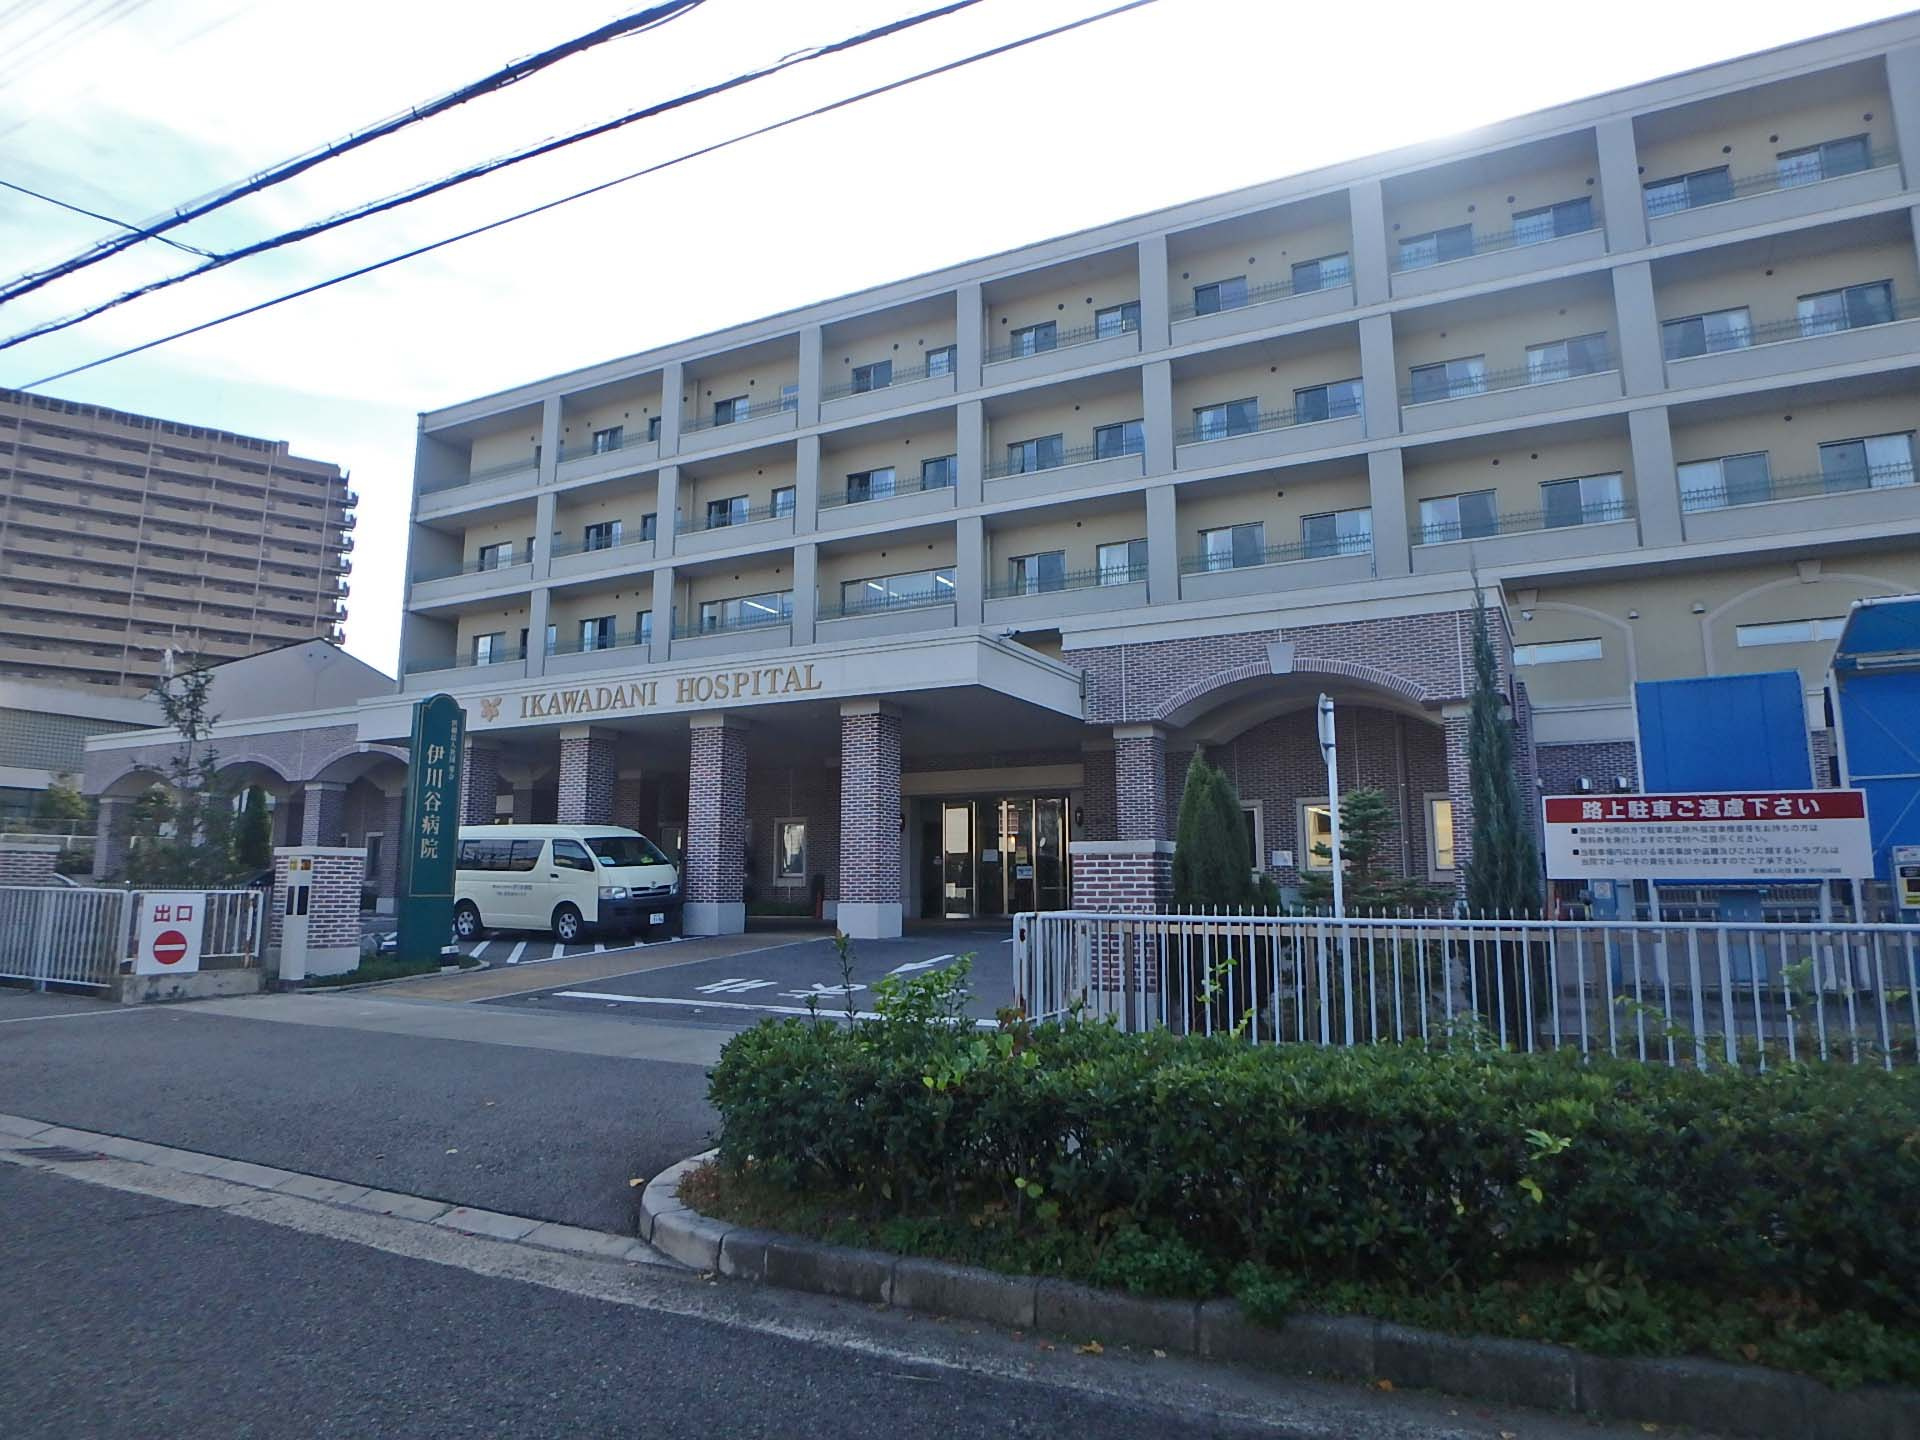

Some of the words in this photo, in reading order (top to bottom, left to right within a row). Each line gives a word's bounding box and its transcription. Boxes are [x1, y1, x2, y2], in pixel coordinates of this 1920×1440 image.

[520, 681, 659, 719] IKAWADANI
[675, 664, 823, 704] HOSPITAL
[420, 743, 445, 859] 伊川谷病院
[1582, 797, 1820, 819] 路上駐車ご遠慮下さい
[153, 904, 193, 922] 出口
